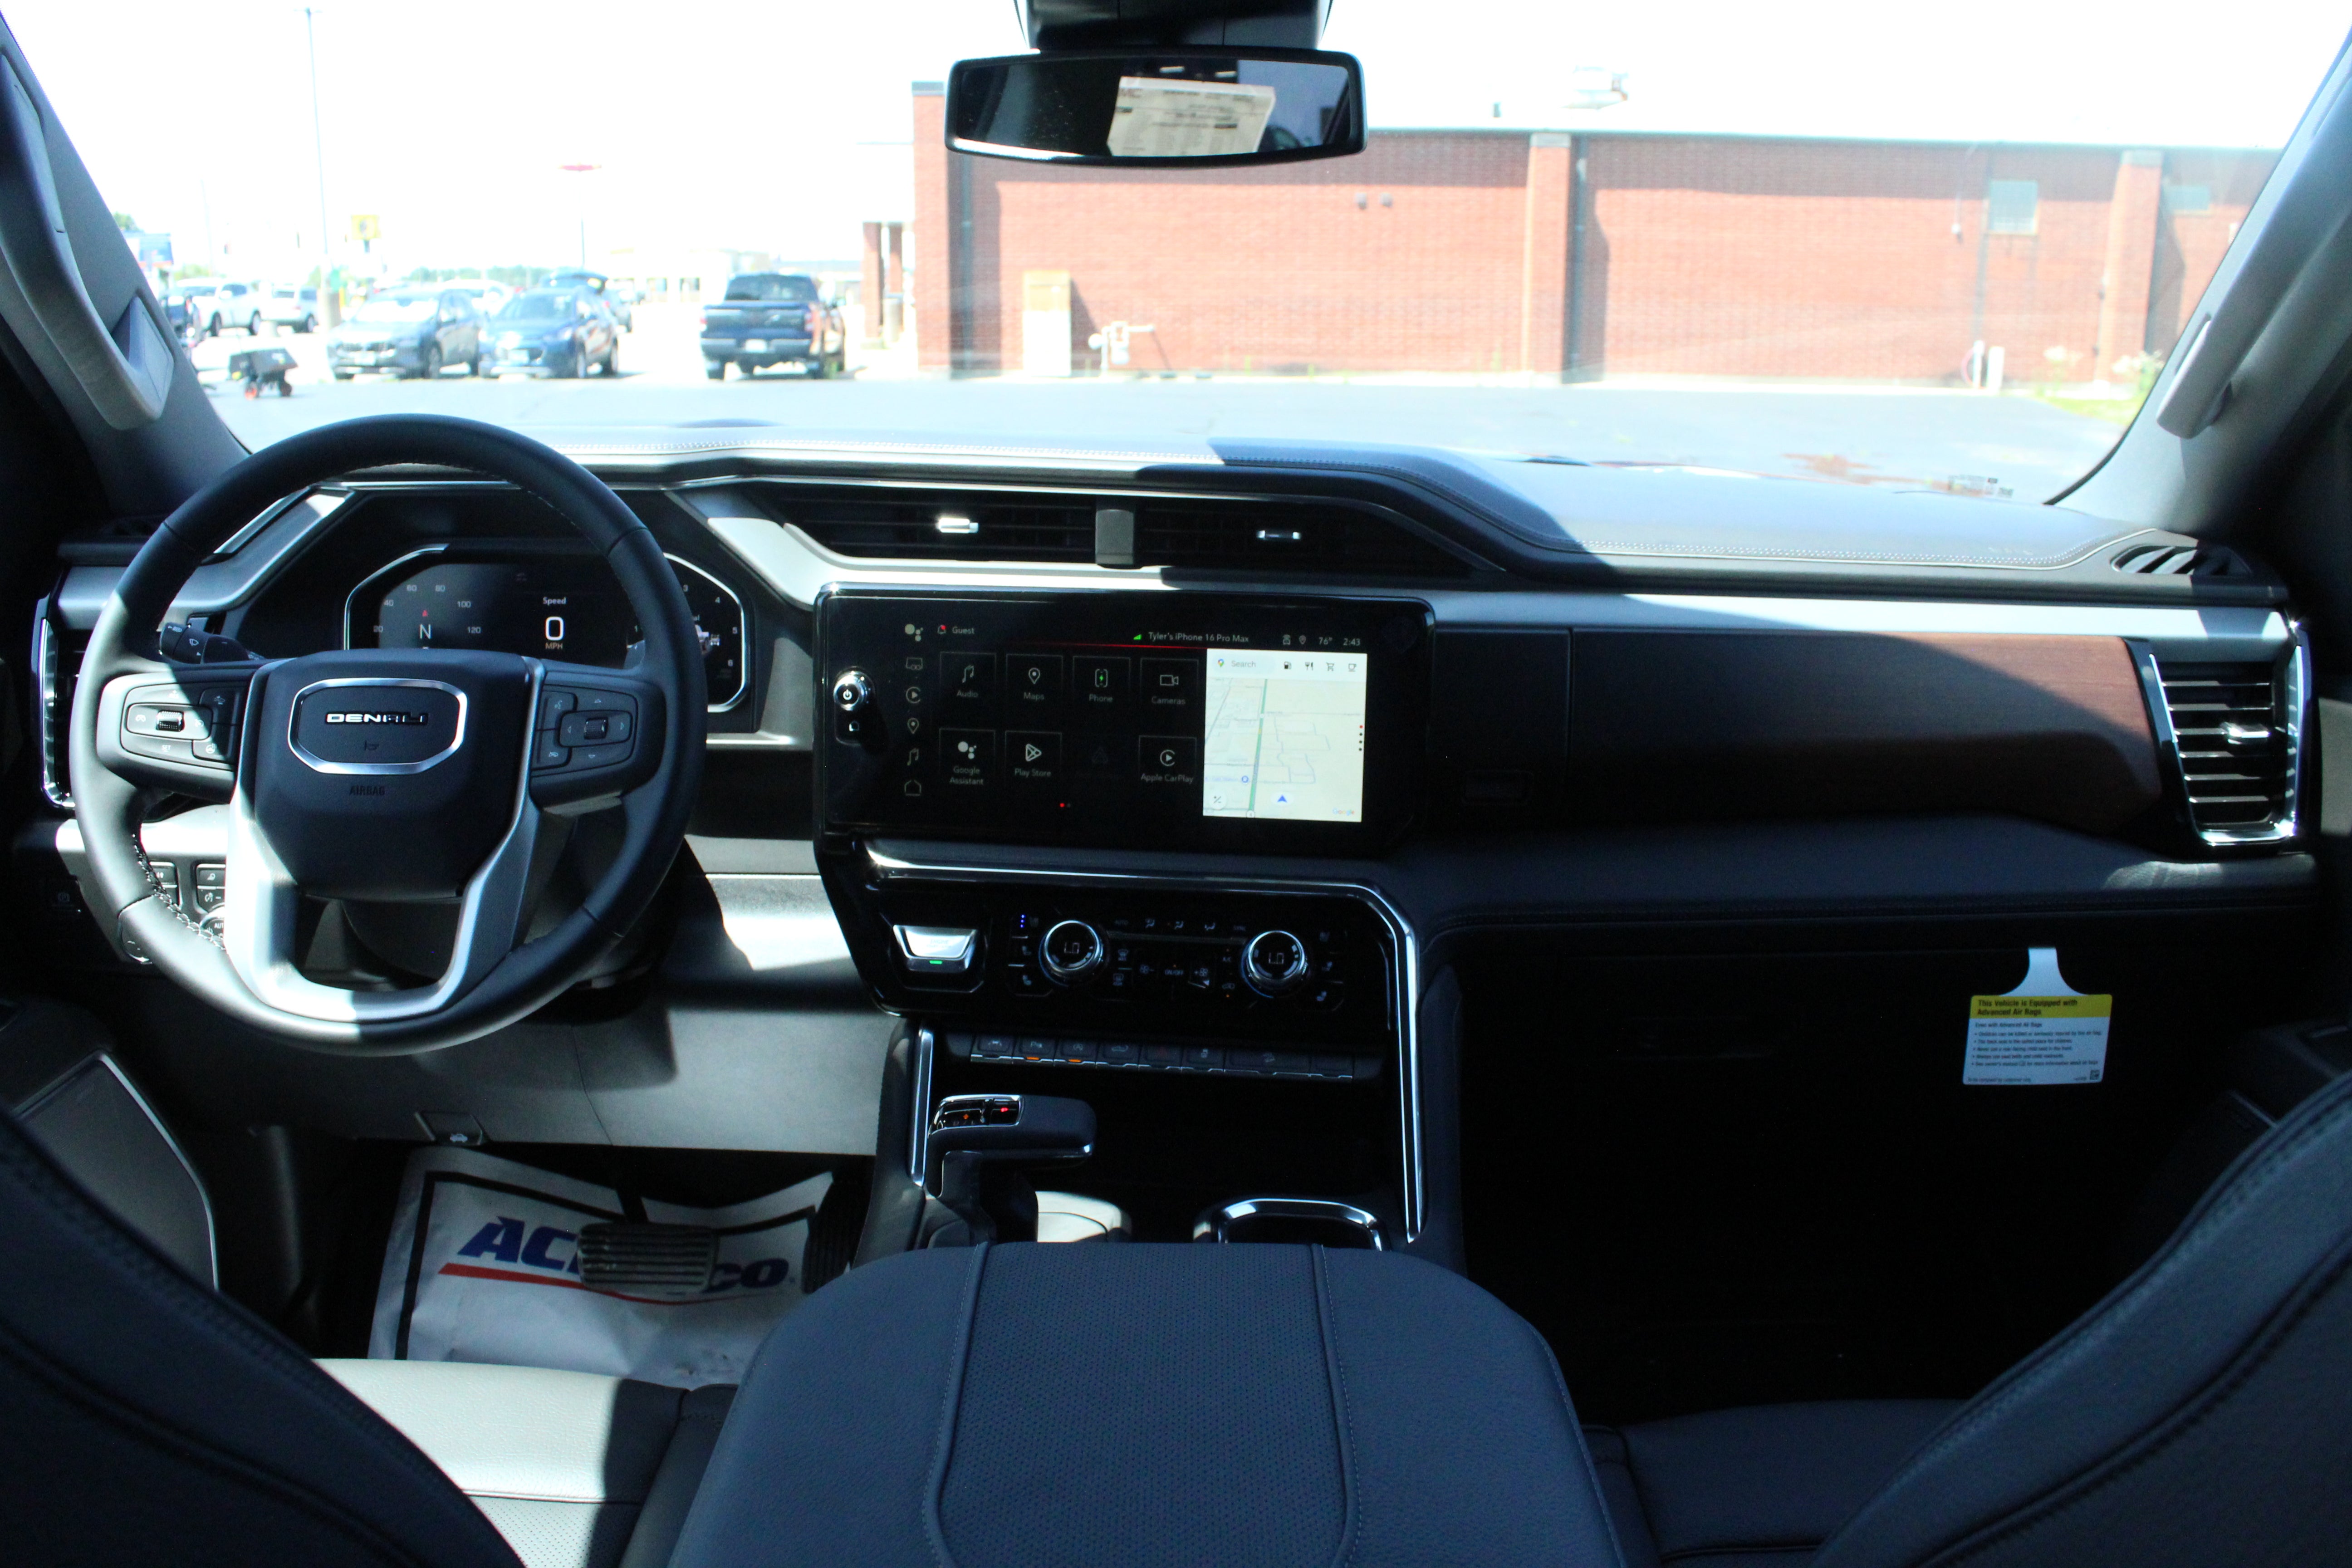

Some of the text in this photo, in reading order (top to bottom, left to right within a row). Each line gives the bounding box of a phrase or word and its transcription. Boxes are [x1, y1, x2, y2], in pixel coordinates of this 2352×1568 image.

[543, 596, 567, 606] Speed
[419, 624, 432, 639] N
[545, 616, 565, 641] 0
[952, 627, 975, 635] Guest
[1148, 632, 1173, 642] Tyler's
[1175, 633, 1202, 642] iPhone
[1343, 637, 1361, 646] 2:43
[1231, 660, 1256, 668] Search
[956, 690, 978, 699] Audio
[1024, 692, 1044, 701] Maps
[1089, 694, 1113, 703] Phone
[1152, 696, 1186, 706] Cameras
[326, 713, 425, 723] DENALI
[953, 766, 980, 776] Google
[1014, 768, 1030, 778] Play
[949, 777, 984, 786] Assistant
[1140, 773, 1163, 783] Apple
[1164, 774, 1194, 784] CarPlay
[349, 785, 385, 796] AIRBAG
[2029, 999, 2061, 1008] Equipped
